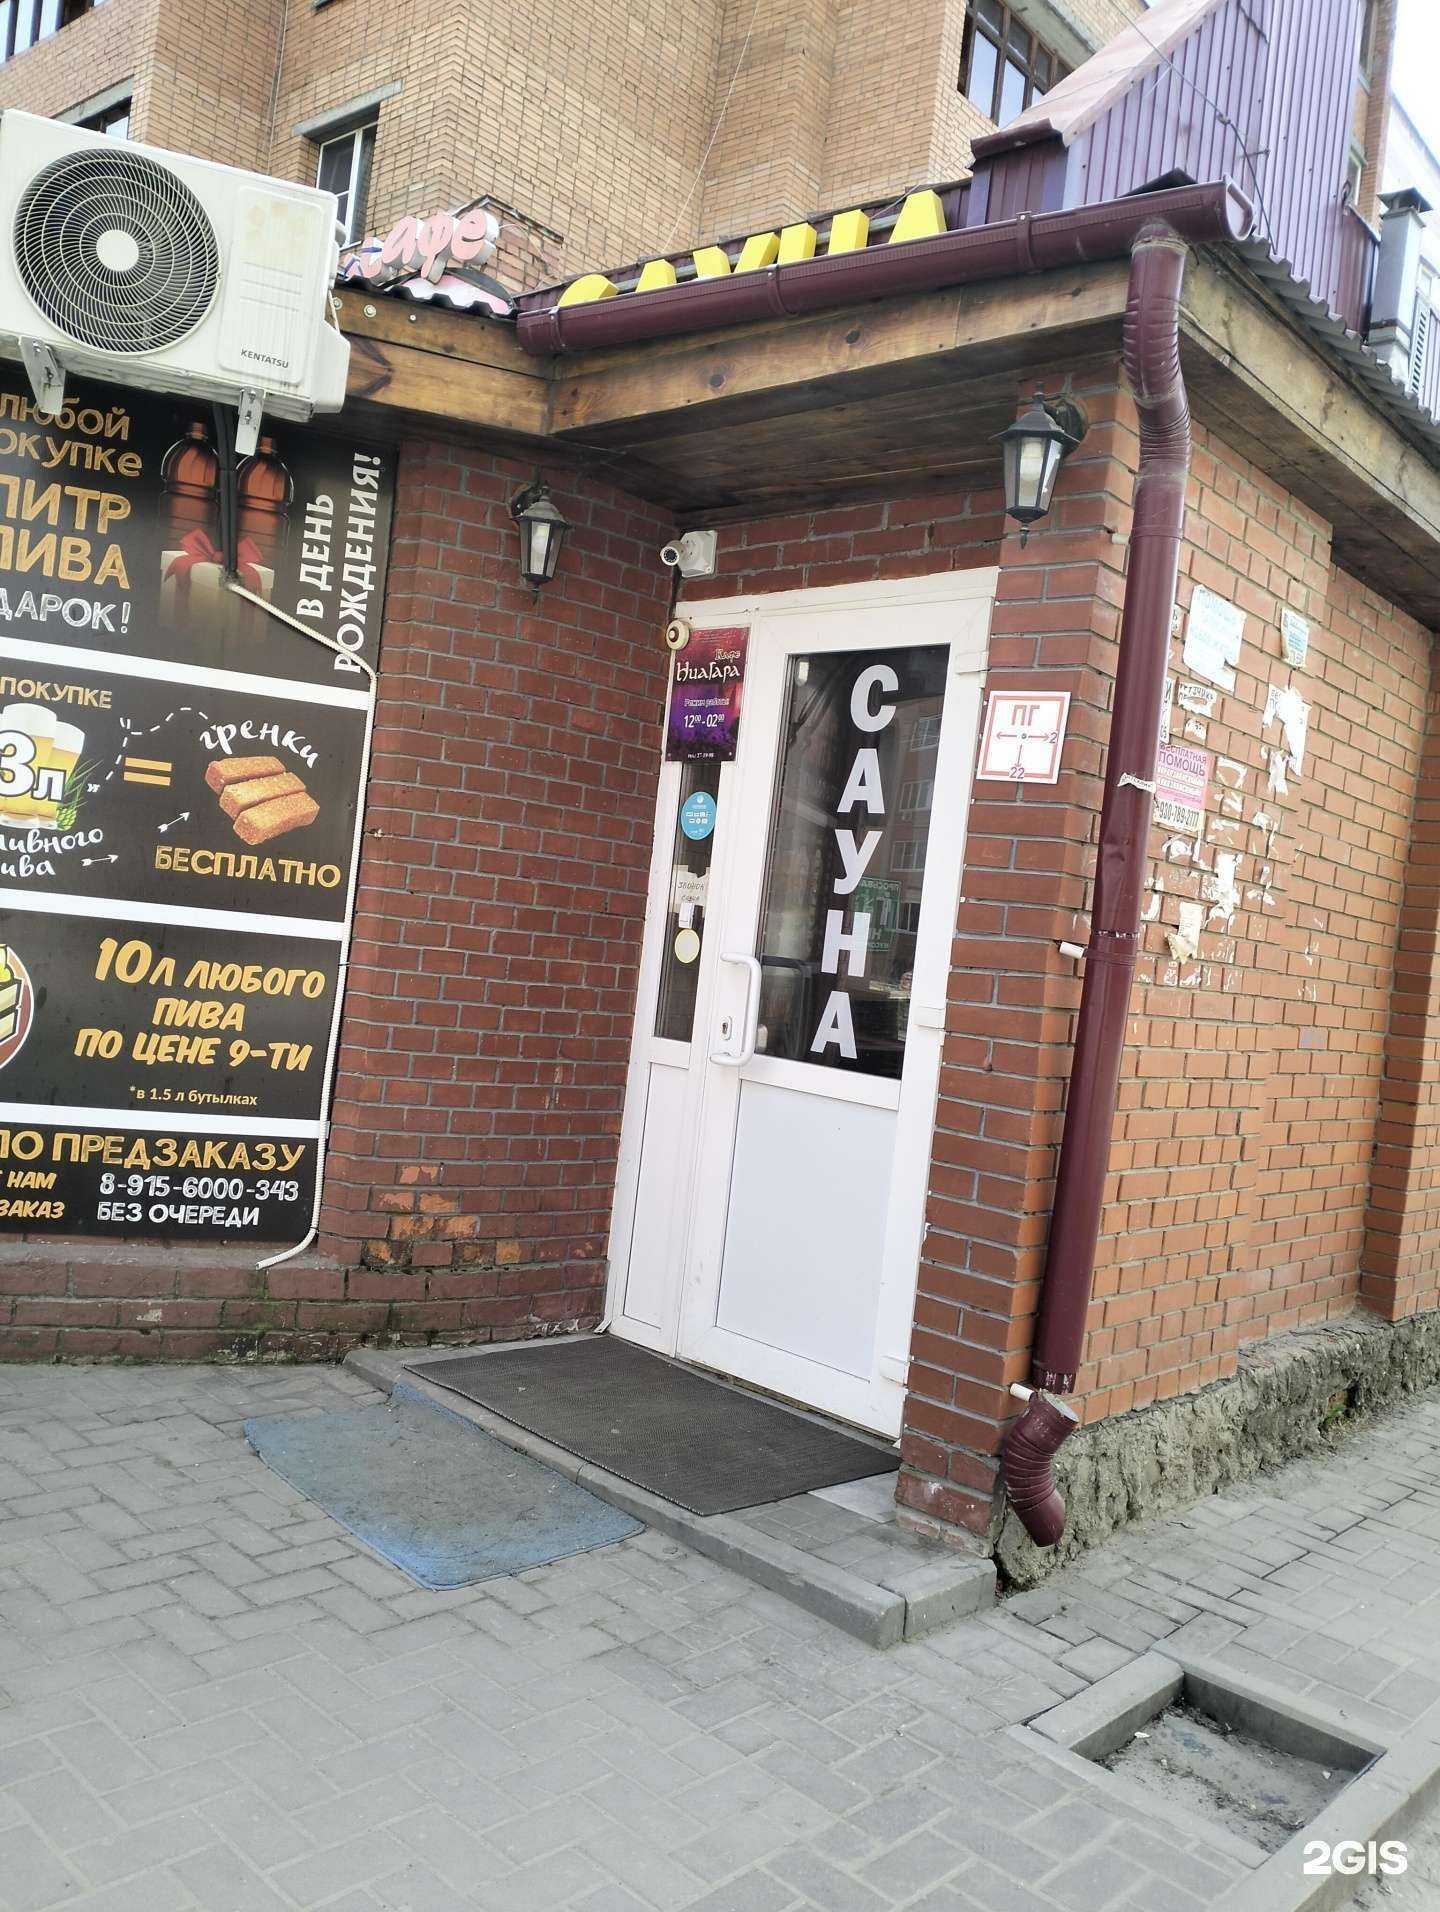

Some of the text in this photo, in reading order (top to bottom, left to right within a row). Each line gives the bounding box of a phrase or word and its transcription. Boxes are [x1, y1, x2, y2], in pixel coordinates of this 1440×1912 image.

[240, 348, 290, 369] KENTATSU
[296, 494, 334, 618] В ДЕНЬ
[334, 452, 381, 674] РОЖДЕНИЯ!
[0, 677, 112, 709] ПОКУПКЕ
[1011, 704, 1041, 726] ПГ
[200, 720, 318, 768] гренки
[1049, 732, 1058, 744] 2
[1009, 766, 1025, 780] 22
[1158, 750, 1205, 777] ПОМОЩЬ
[155, 846, 341, 888] БЕСПЛАТНО
[810, 664, 899, 1060] САУНА
[184, 960, 326, 998] ЛЮБОГО
[152, 998, 245, 1031] ПИВА
[74, 1028, 313, 1071] ПО ЦЕНЕ 9-ТИ
[150, 1088, 171, 1100] 1.5
[175, 1091, 184, 1101] л
[188, 1090, 258, 1105] бутылках
[52, 1132, 306, 1171] ПРЕДЗАКАЗУ
[7, 1171, 57, 1189] НАМ
[100, 1172, 299, 1201] 8-915-6000-343
[97, 1201, 260, 1228] БЕЗ ОЧЕРЕДИ
